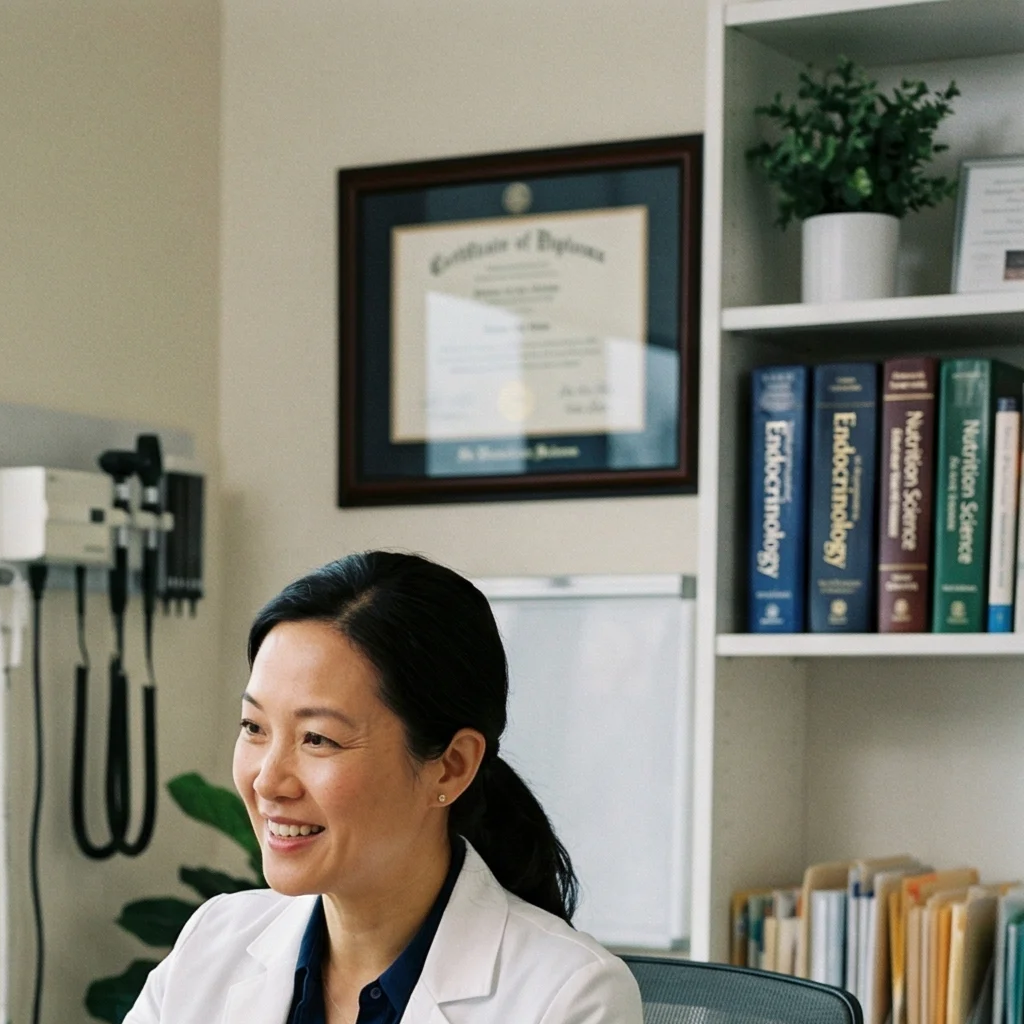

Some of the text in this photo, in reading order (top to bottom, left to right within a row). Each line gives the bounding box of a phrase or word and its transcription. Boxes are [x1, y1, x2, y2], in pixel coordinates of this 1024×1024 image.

[903, 410, 924, 486] Nutrition
[961, 419, 980, 498] Nutrition
[757, 420, 787, 579] Endocrinology
[824, 412, 857, 569] Endocrinology
[902, 488, 922, 551] Science
[958, 501, 978, 564] Science
